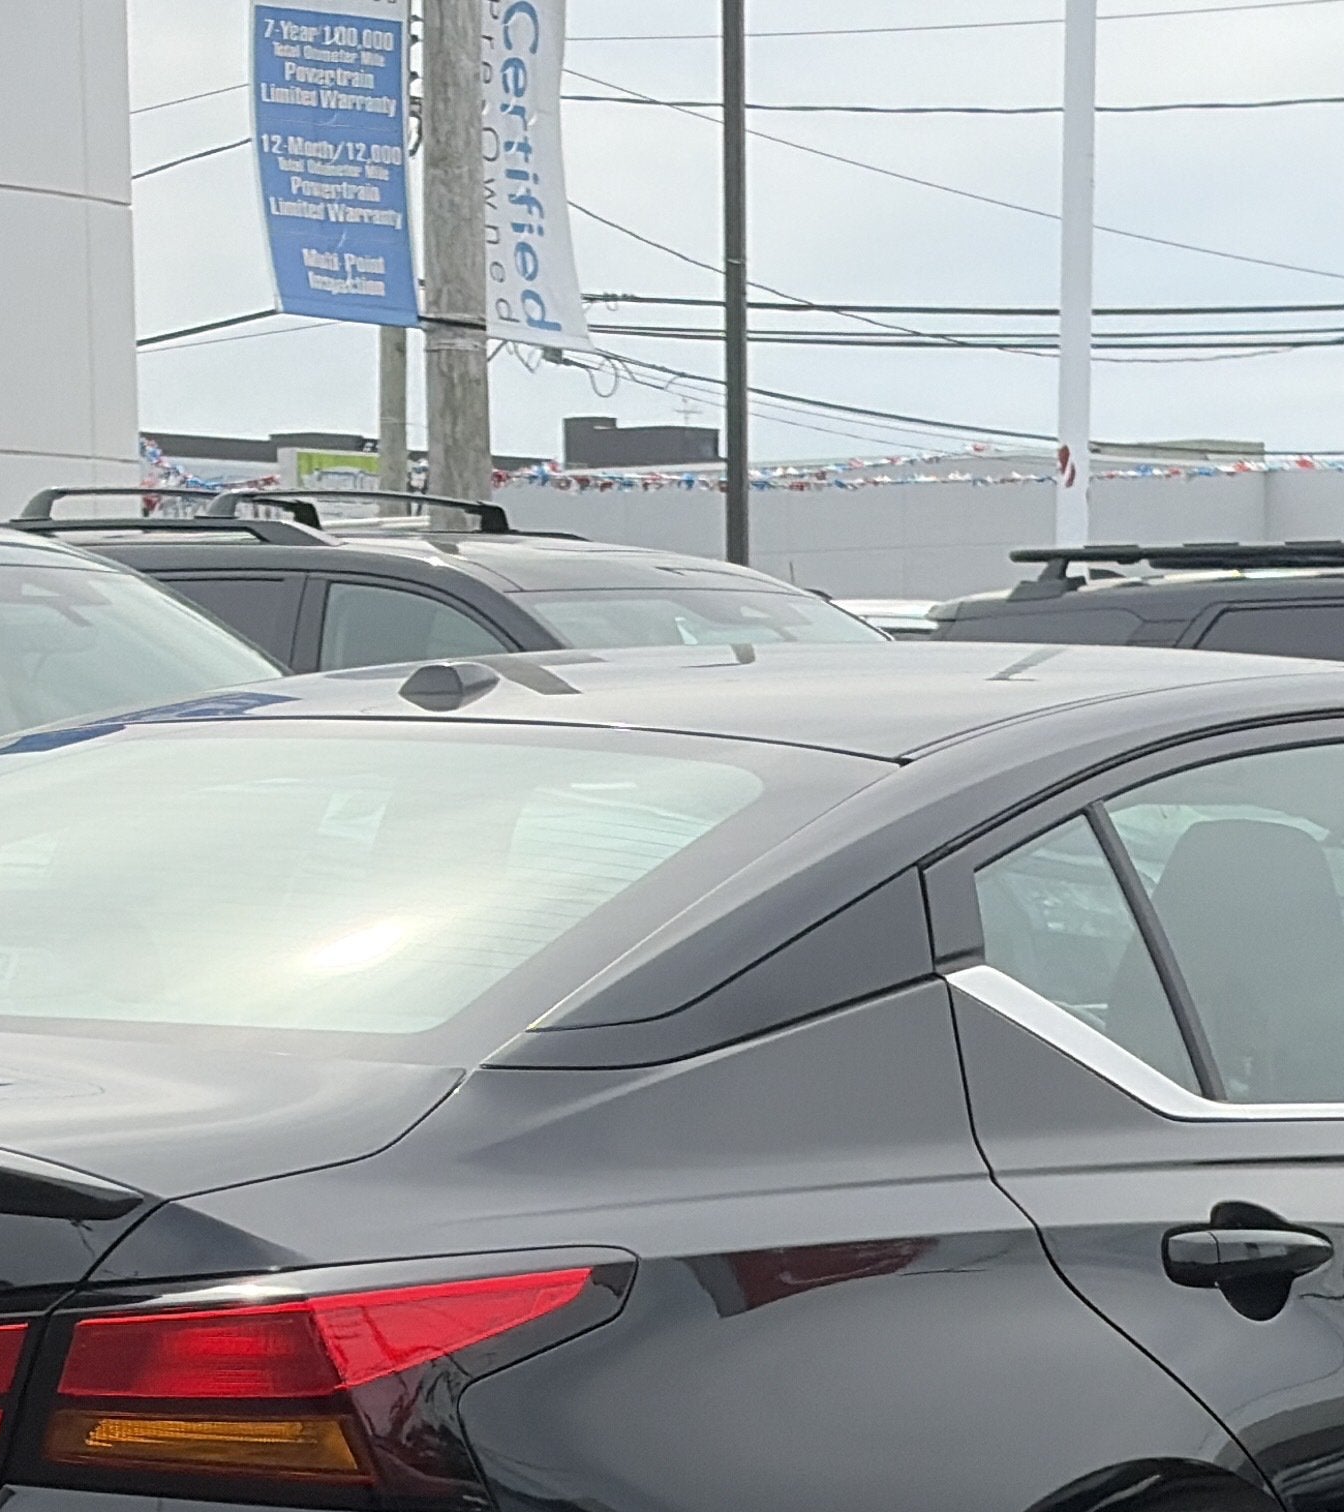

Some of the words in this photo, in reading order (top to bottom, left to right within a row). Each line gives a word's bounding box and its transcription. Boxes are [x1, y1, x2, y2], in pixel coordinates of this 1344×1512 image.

[264, 18, 315, 42] 7-Year
[321, 24, 394, 51] 100,000
[284, 61, 375, 89] Powertrain
[260, 83, 318, 107] Limited
[320, 89, 396, 118] Warranty
[500, 1, 561, 331] Certified
[290, 175, 381, 202] Powertrain
[269, 196, 325, 220] Limited
[327, 203, 402, 230] Warranty
